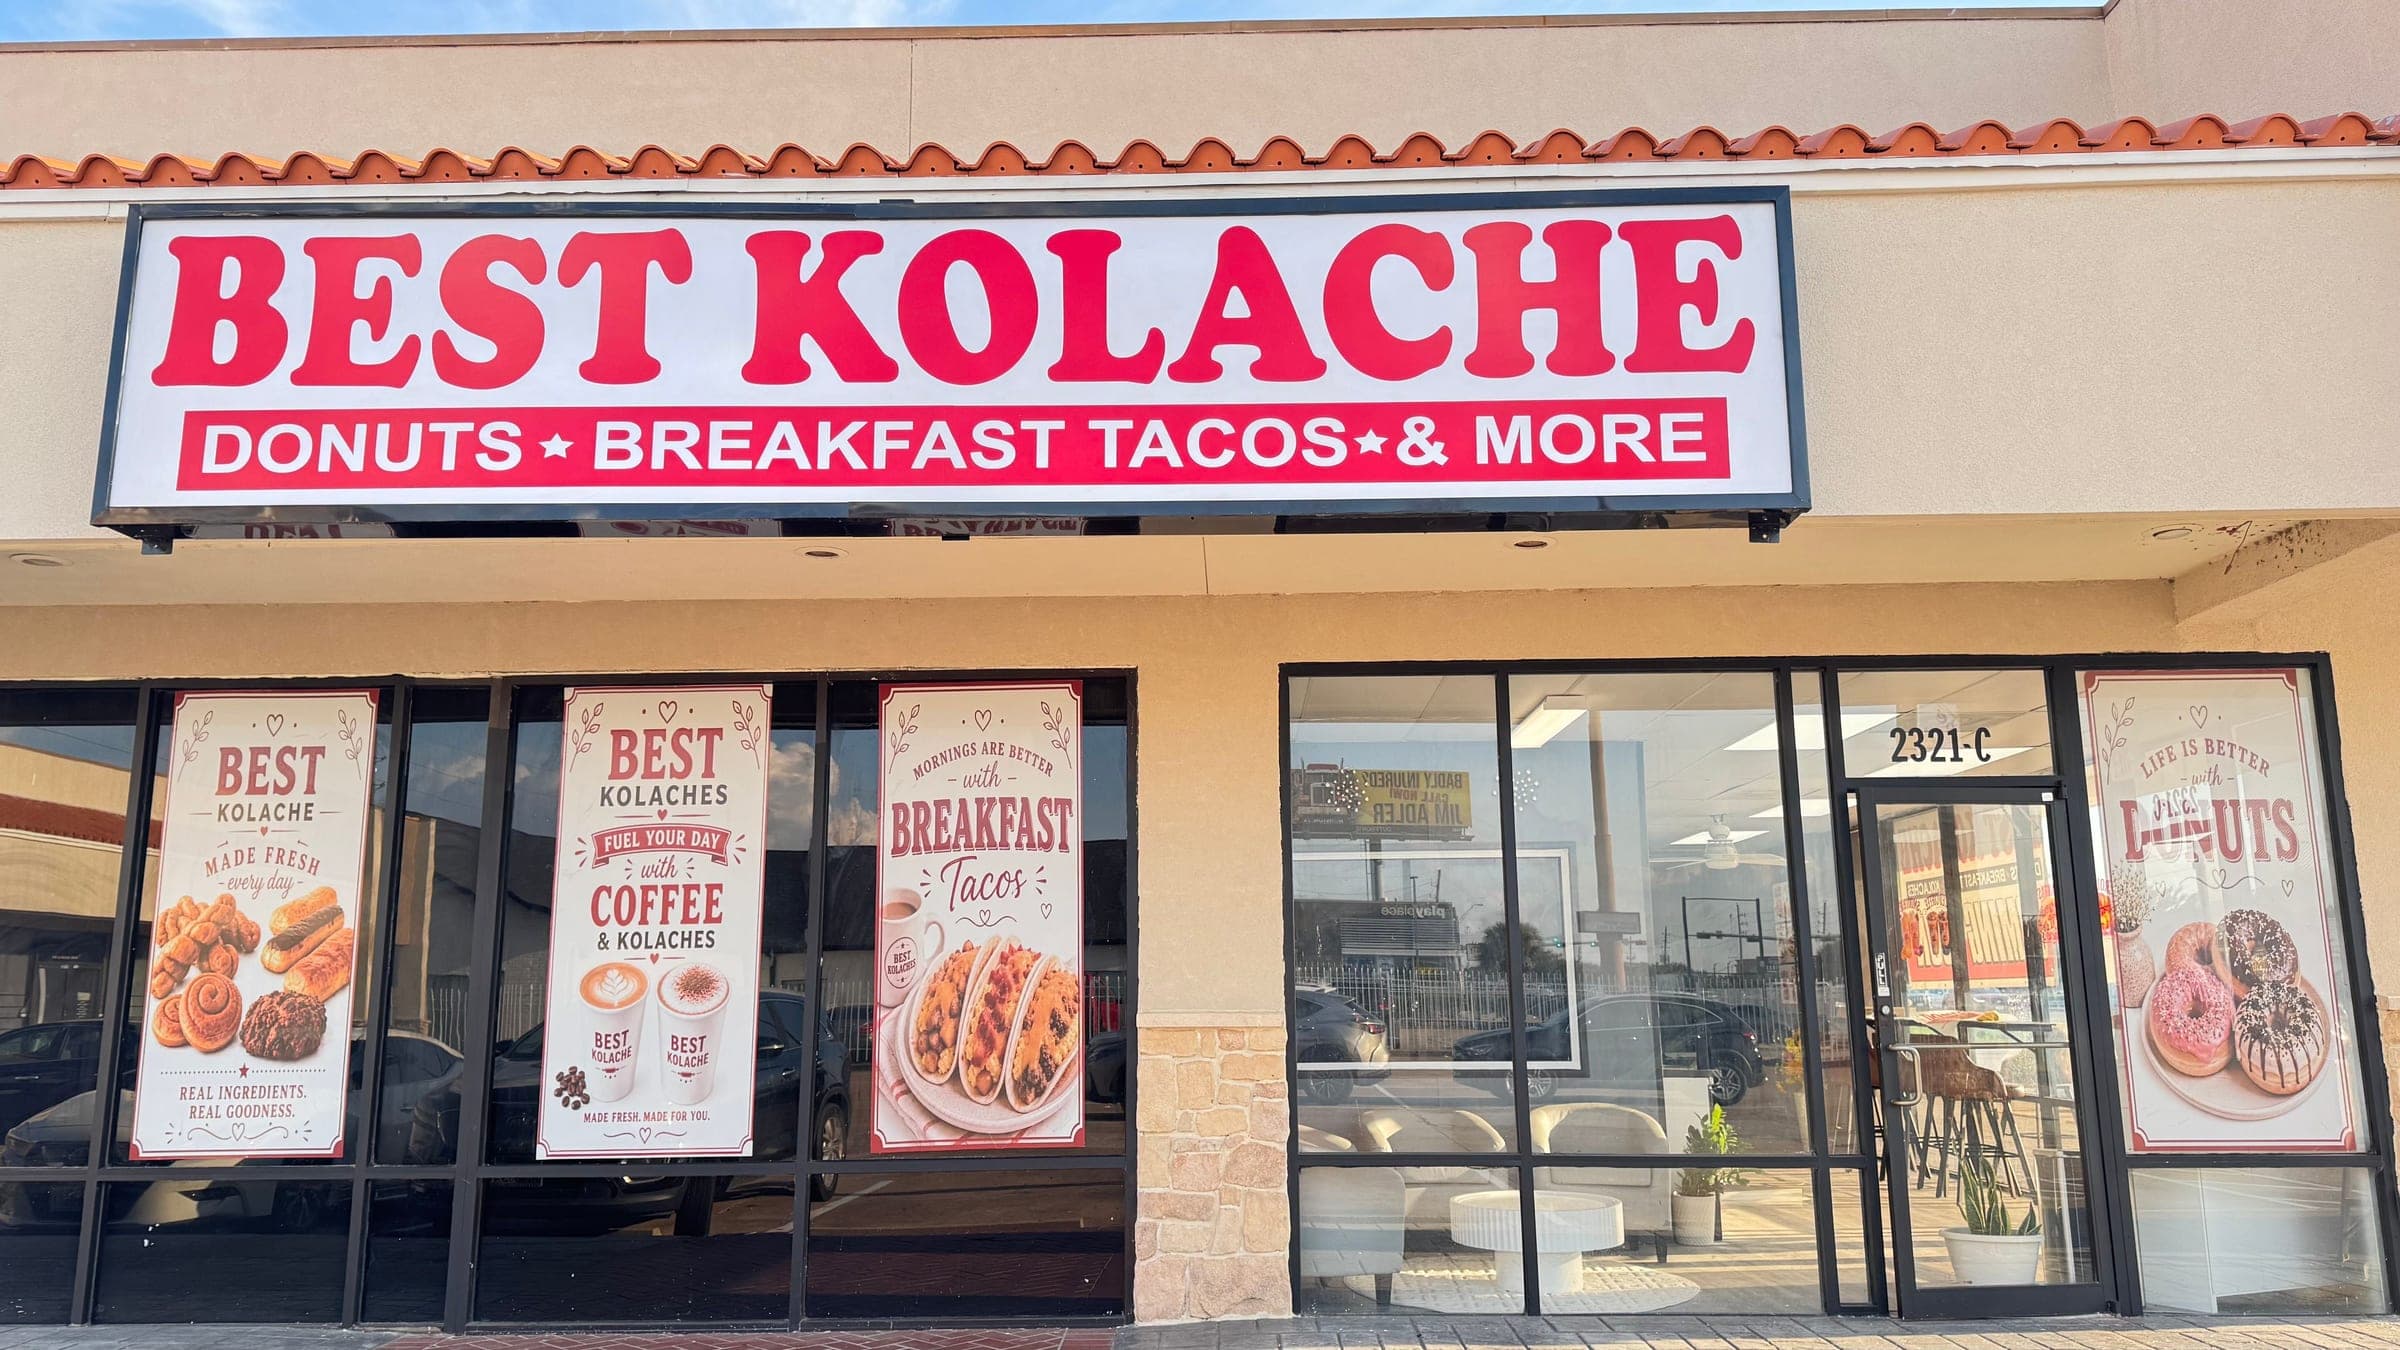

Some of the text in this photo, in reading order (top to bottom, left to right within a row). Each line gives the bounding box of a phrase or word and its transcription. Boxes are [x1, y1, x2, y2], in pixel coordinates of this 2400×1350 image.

[151, 214, 1755, 390] BEST KOLACHE
[201, 412, 1707, 474] DONUTS BREAKFAST TACOS & MORE
[608, 728, 724, 780] BEST
[1890, 727, 1991, 763] 2321-C
[912, 741, 1055, 781] MORNINGS ARE BETTER
[2140, 738, 2271, 779] LIFE IS BETTER
[215, 746, 326, 796] BEST
[962, 761, 1002, 788] with
[2191, 764, 2223, 788] with
[600, 783, 728, 807] KOLACHES
[217, 802, 314, 823] KOLACHE
[890, 797, 1074, 858] BREAKFAST
[604, 830, 720, 851] FUEL YOUR DAY
[204, 845, 321, 877] MADE FRESH
[641, 855, 677, 879] with
[227, 869, 294, 899] every day
[940, 855, 1027, 912] Tacos
[590, 883, 723, 927] COFFEE
[597, 930, 715, 951] & KOLACHES
[887, 959, 916, 975] KOLACHES
[893, 950, 912, 964] BEST
[1877, 954, 1886, 986] PULL
[594, 1029, 630, 1050] BEST
[670, 1034, 707, 1054] BEST
[591, 1046, 632, 1064] KOLACHE
[667, 1051, 709, 1068] KOLACHE
[179, 1084, 307, 1101] REAL INGREDIENTS.
[189, 1103, 295, 1120] REAL GOODNESS.
[583, 1110, 711, 1123] MADE FRESH. MADE FOR YOU.
